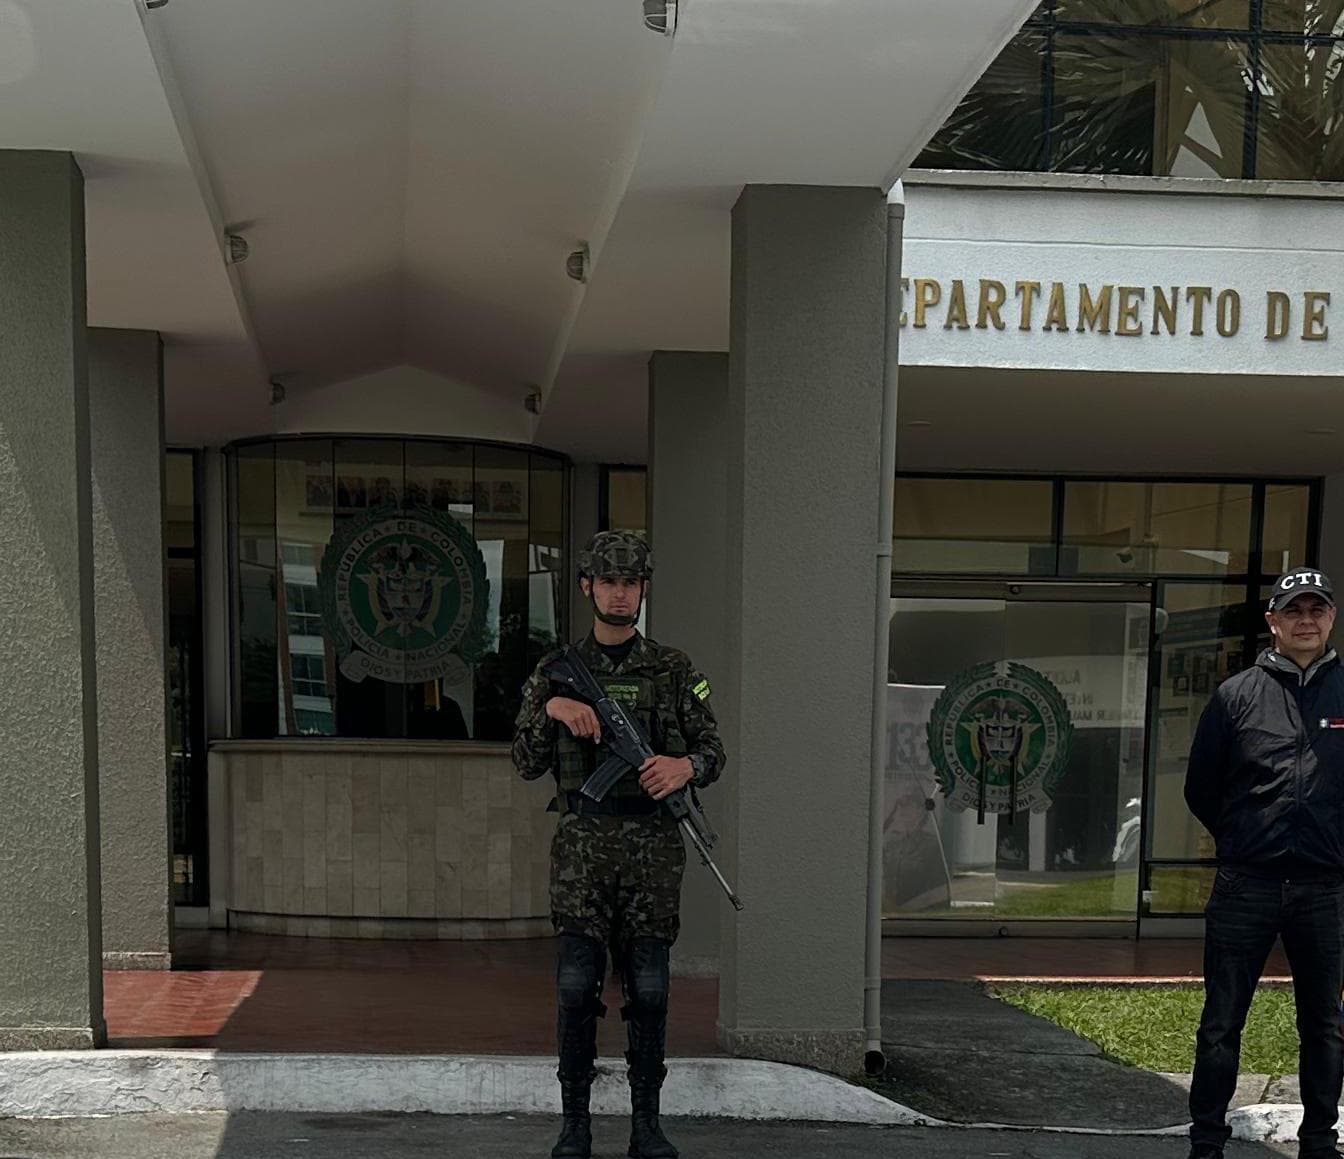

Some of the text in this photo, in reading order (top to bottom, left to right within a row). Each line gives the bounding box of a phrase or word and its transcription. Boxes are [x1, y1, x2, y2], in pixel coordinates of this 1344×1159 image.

[1264, 289, 1332, 341] DE
[396, 521, 418, 534] DE
[1280, 572, 1323, 590] CTI
[999, 761, 1050, 795] NCIONAL
